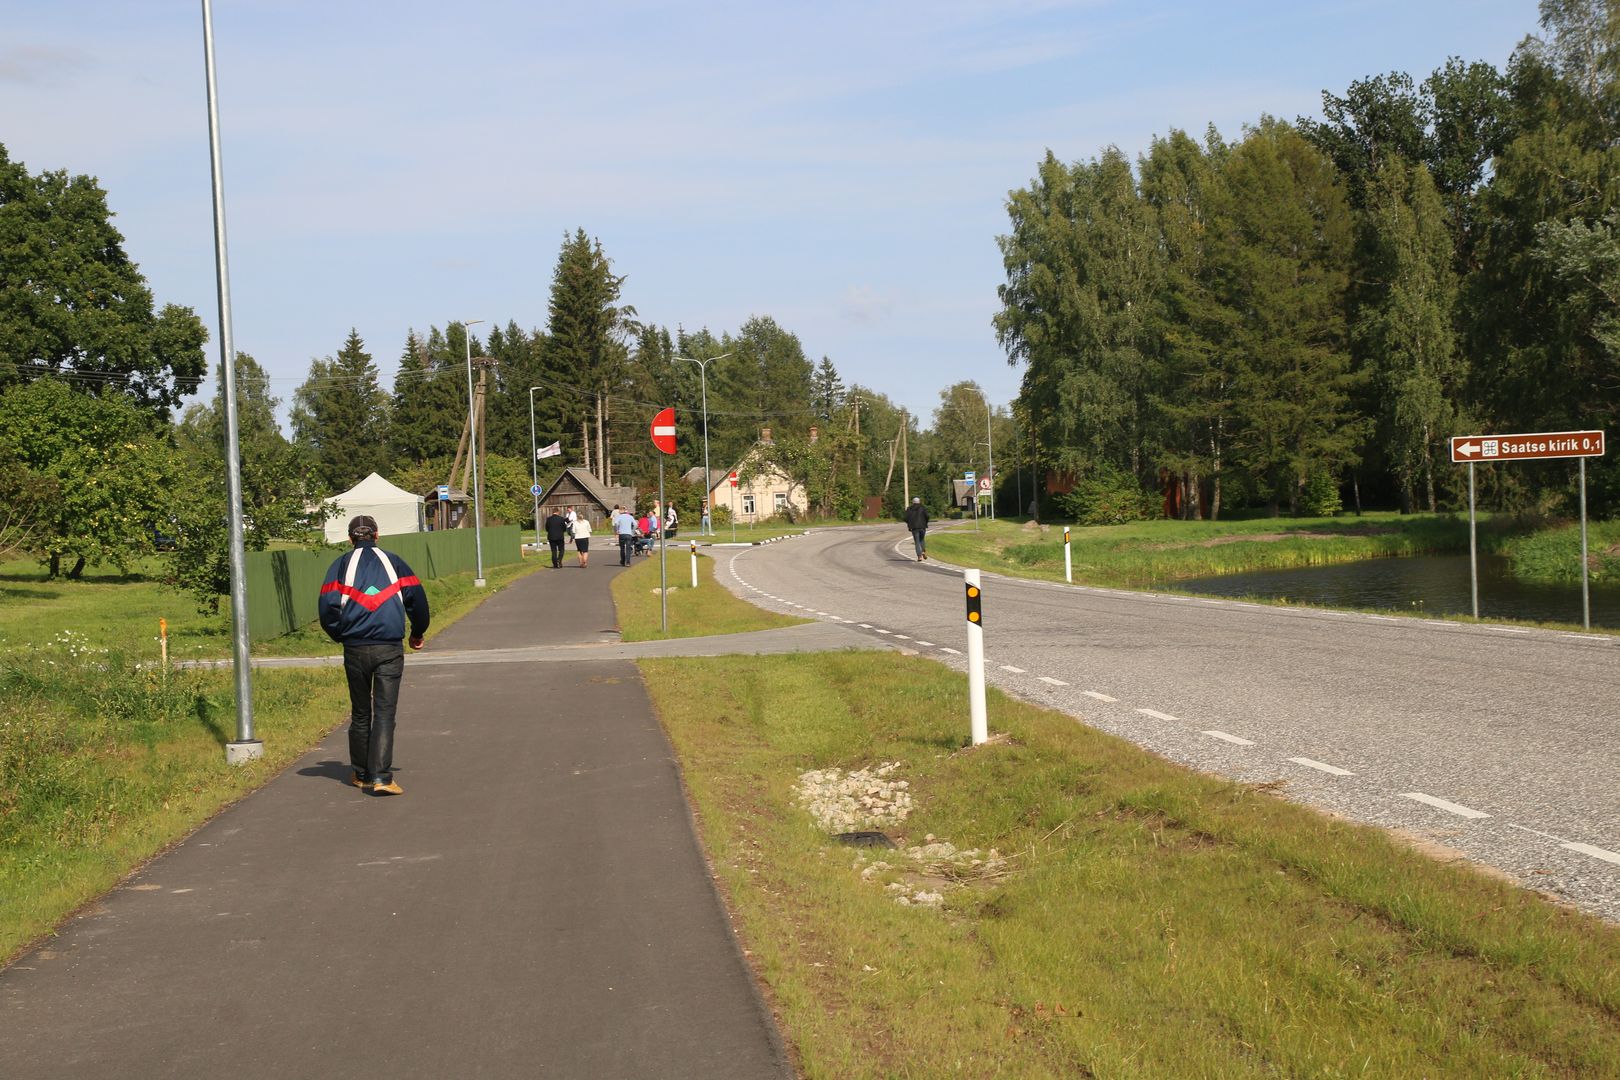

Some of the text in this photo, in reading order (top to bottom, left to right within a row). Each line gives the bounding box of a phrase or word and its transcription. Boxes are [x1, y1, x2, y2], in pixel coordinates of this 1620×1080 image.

[1501, 438, 1601, 454] Saatse kirik 0,1
